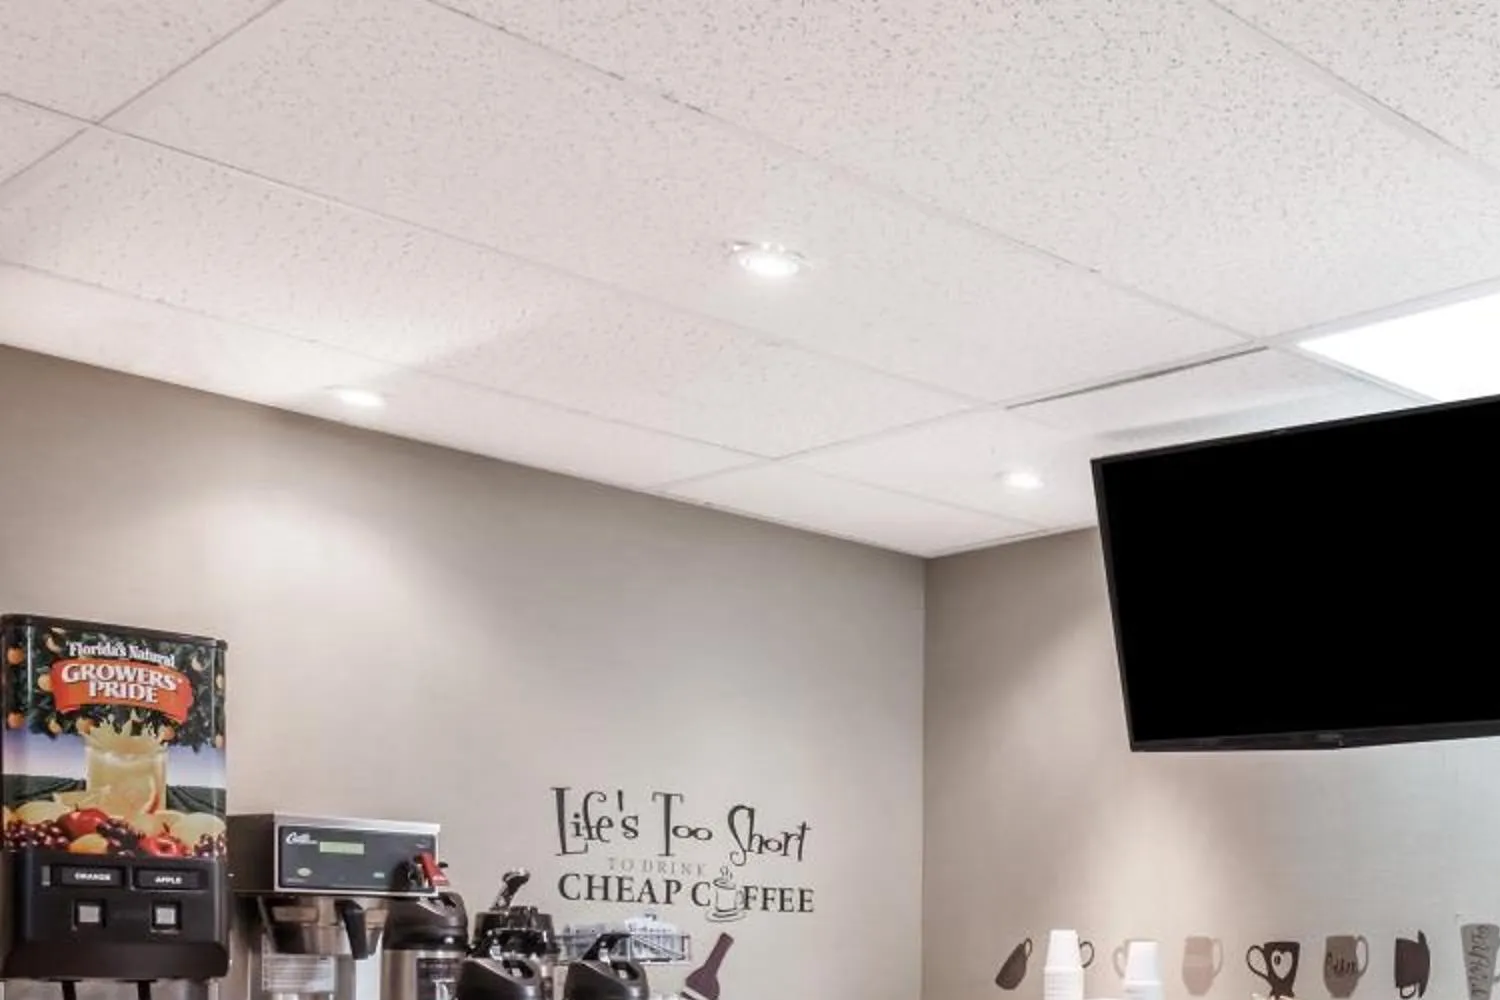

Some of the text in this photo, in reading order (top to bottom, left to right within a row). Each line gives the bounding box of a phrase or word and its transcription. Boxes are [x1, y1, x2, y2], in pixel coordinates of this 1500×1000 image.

[88, 679, 158, 703] PRIDE
[550, 786, 811, 866] Life's Too Short
[607, 857, 709, 877] TO DRINK
[154, 875, 183, 885] APPLE
[557, 872, 682, 905] CHEAP
